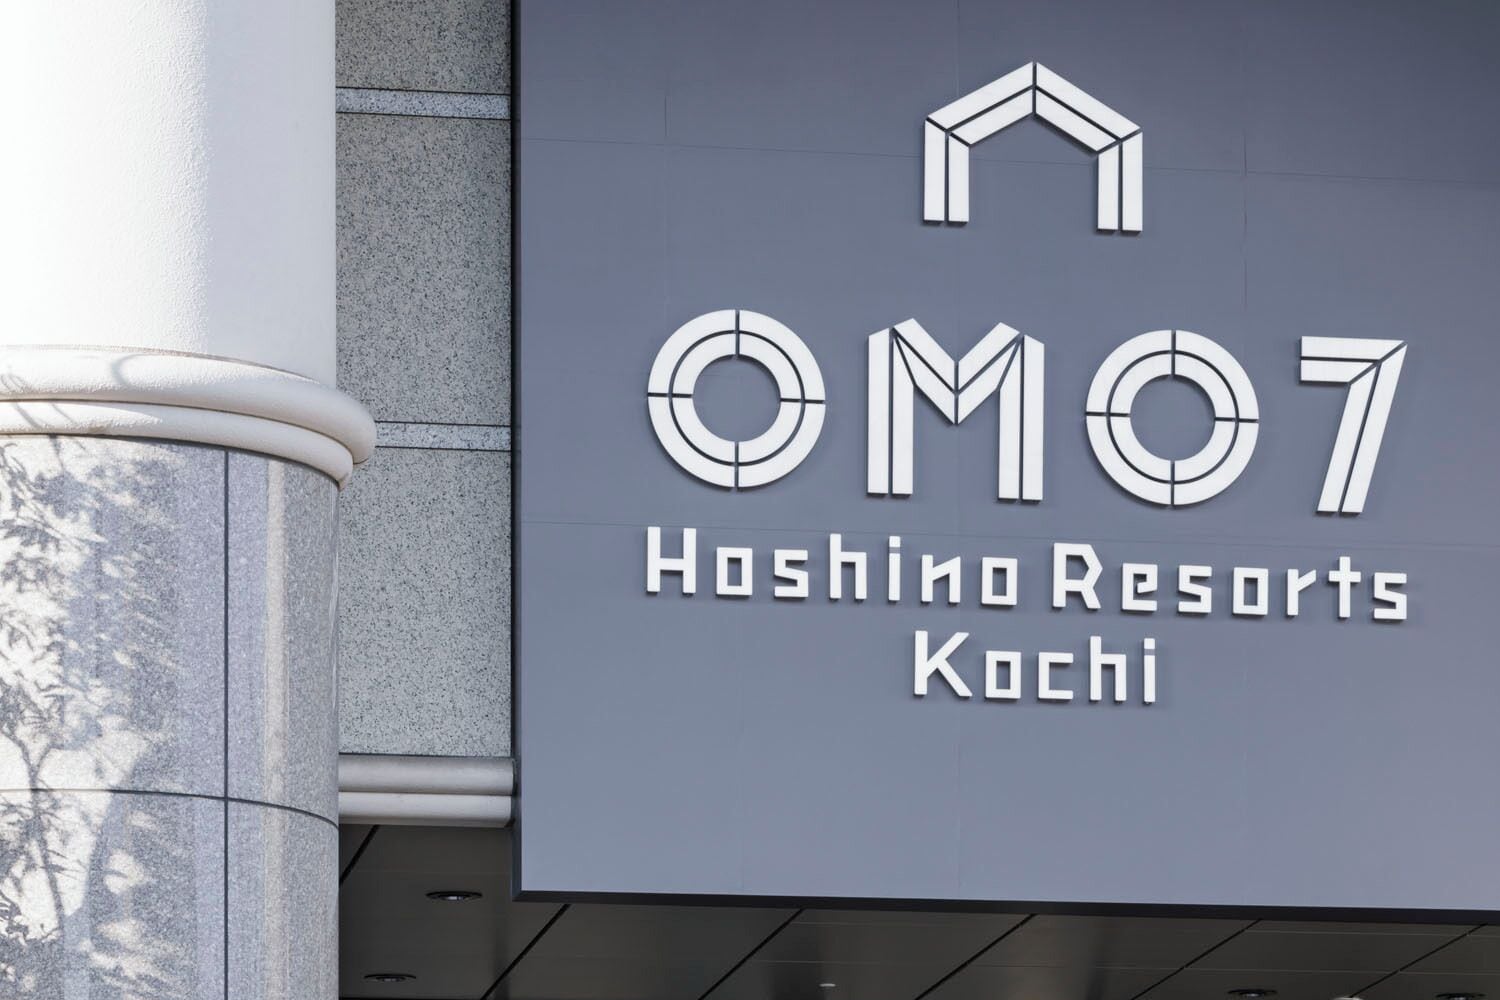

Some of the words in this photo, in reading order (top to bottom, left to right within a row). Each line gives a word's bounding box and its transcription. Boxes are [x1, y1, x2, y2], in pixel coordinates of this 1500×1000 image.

[646, 526, 1018, 606] Hoshino
[1052, 542, 1408, 621] Resorts
[913, 630, 1156, 703] Kochi
